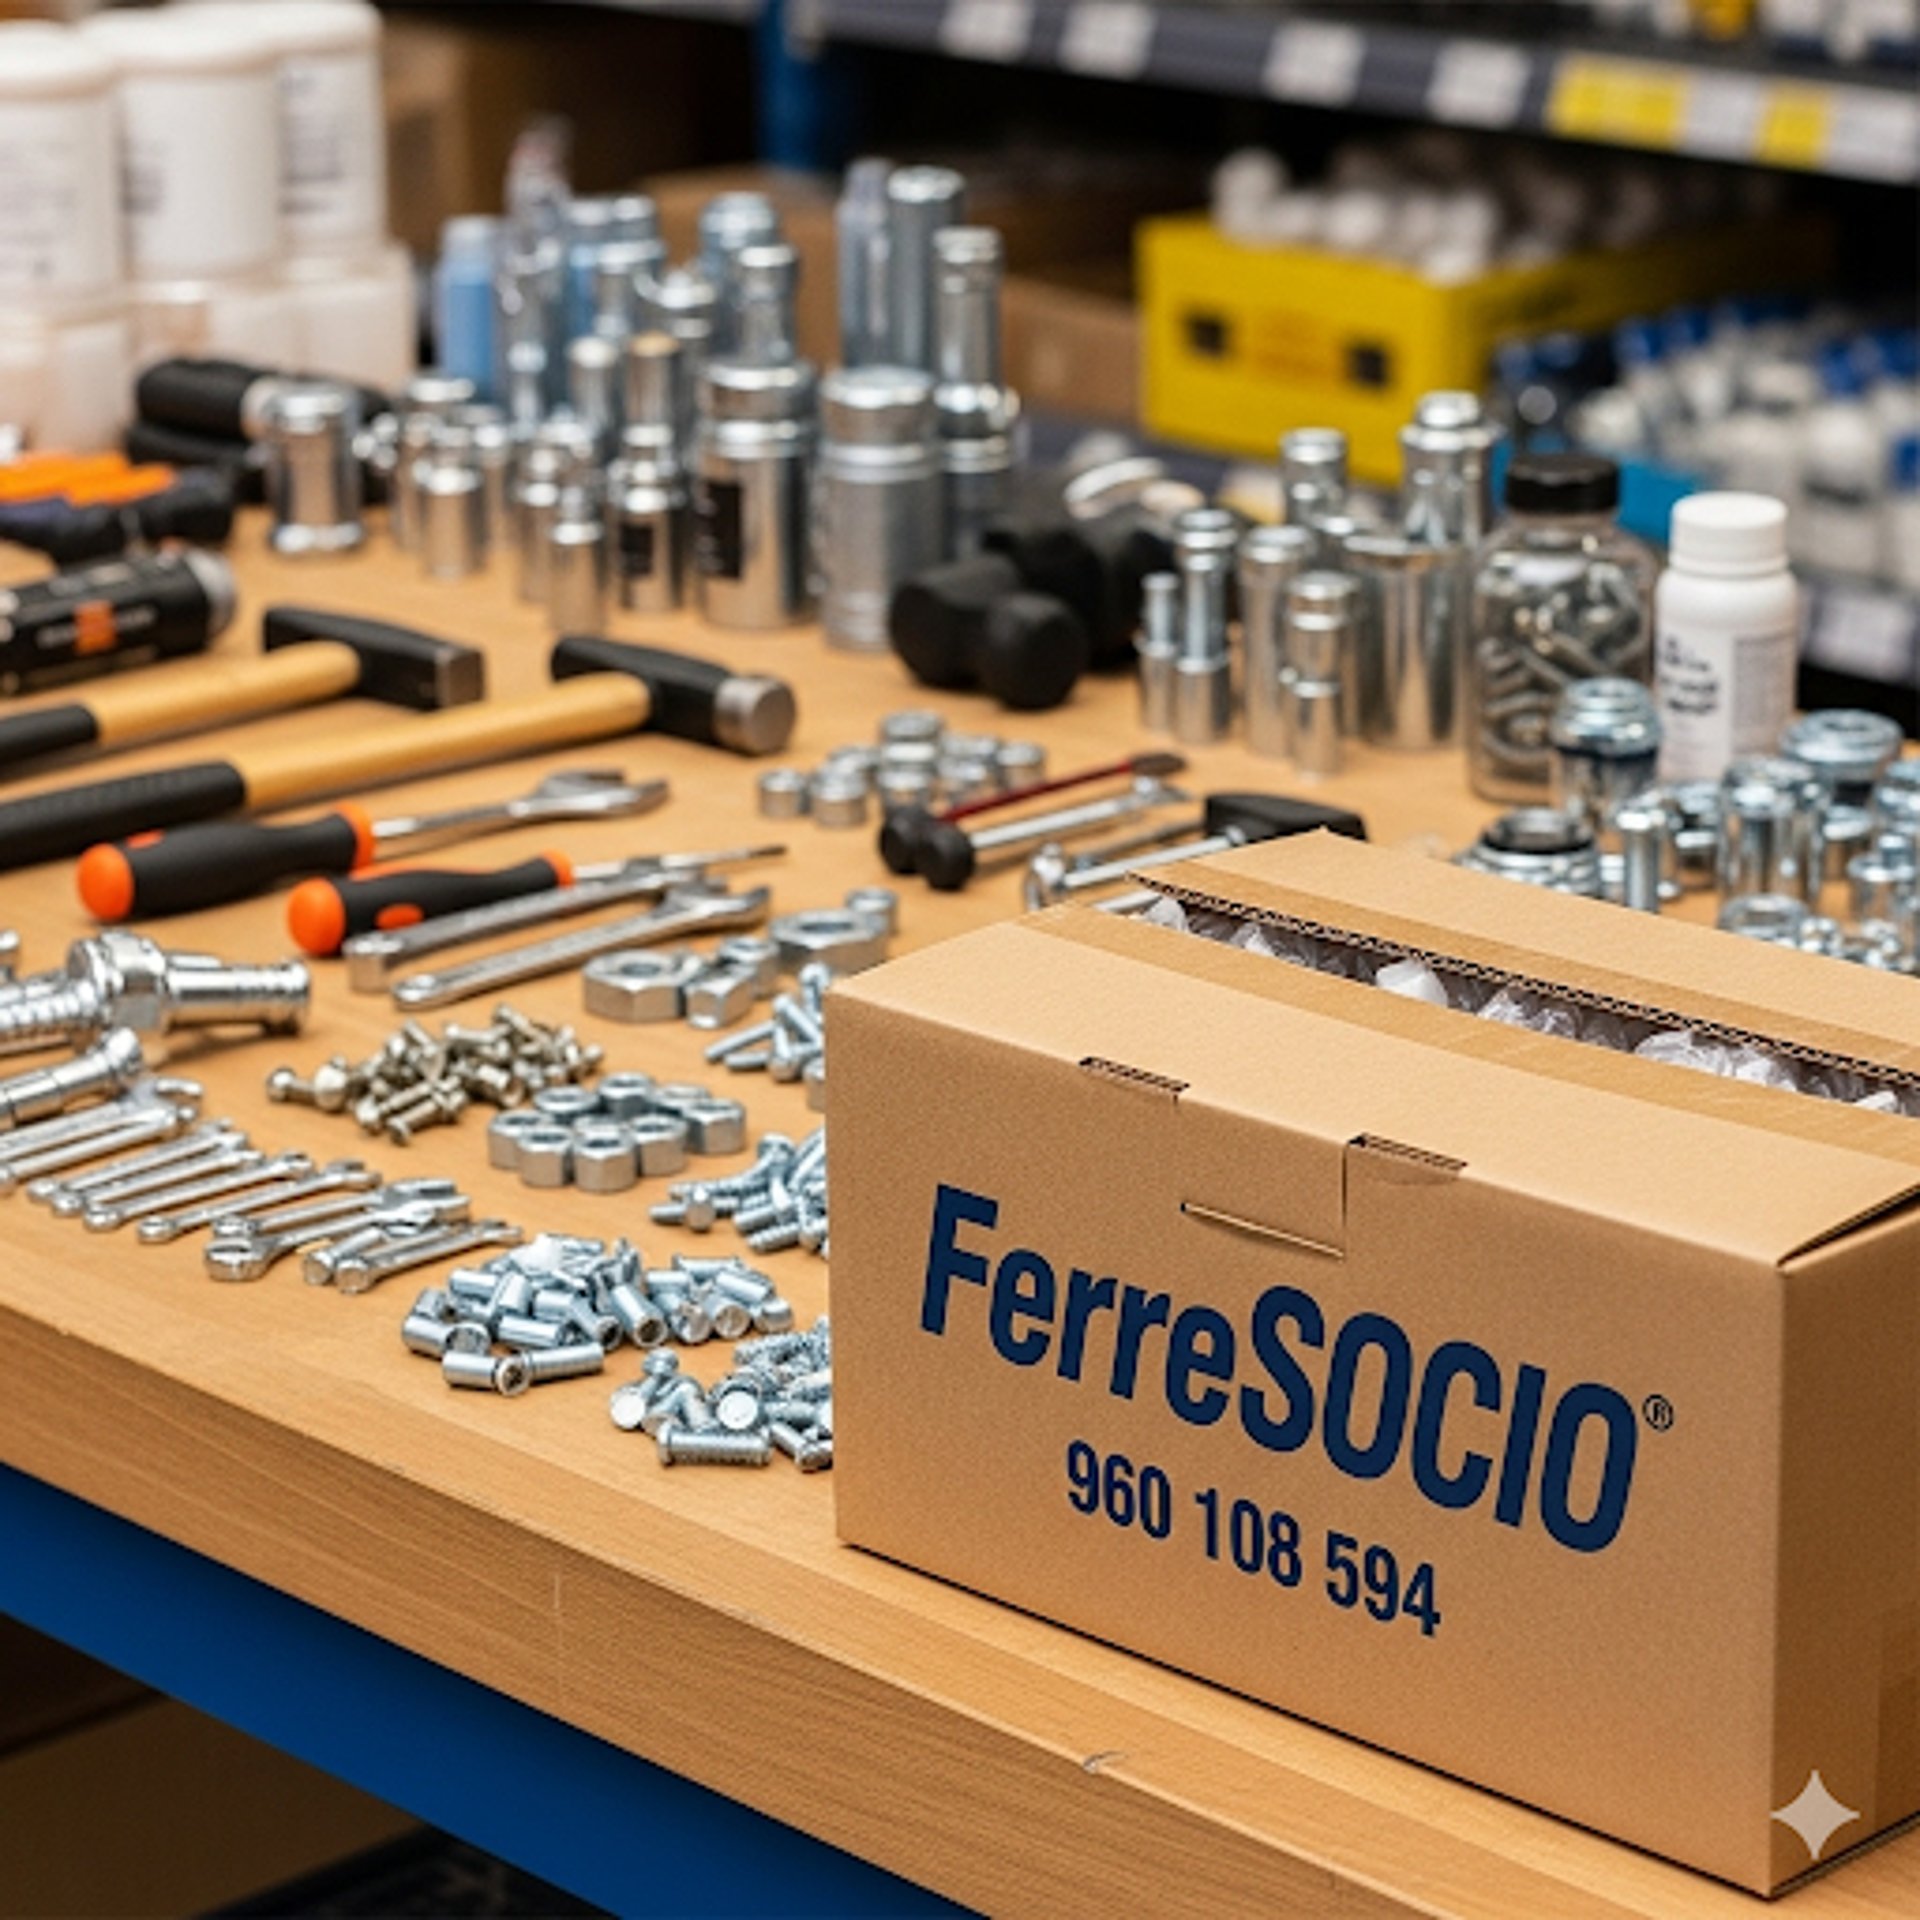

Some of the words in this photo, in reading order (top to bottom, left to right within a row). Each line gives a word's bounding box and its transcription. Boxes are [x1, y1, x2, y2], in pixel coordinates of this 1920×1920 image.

[1067, 1439, 1172, 1540] 960
[1194, 1487, 1303, 1588] 108
[1326, 1530, 1441, 1637] 594
